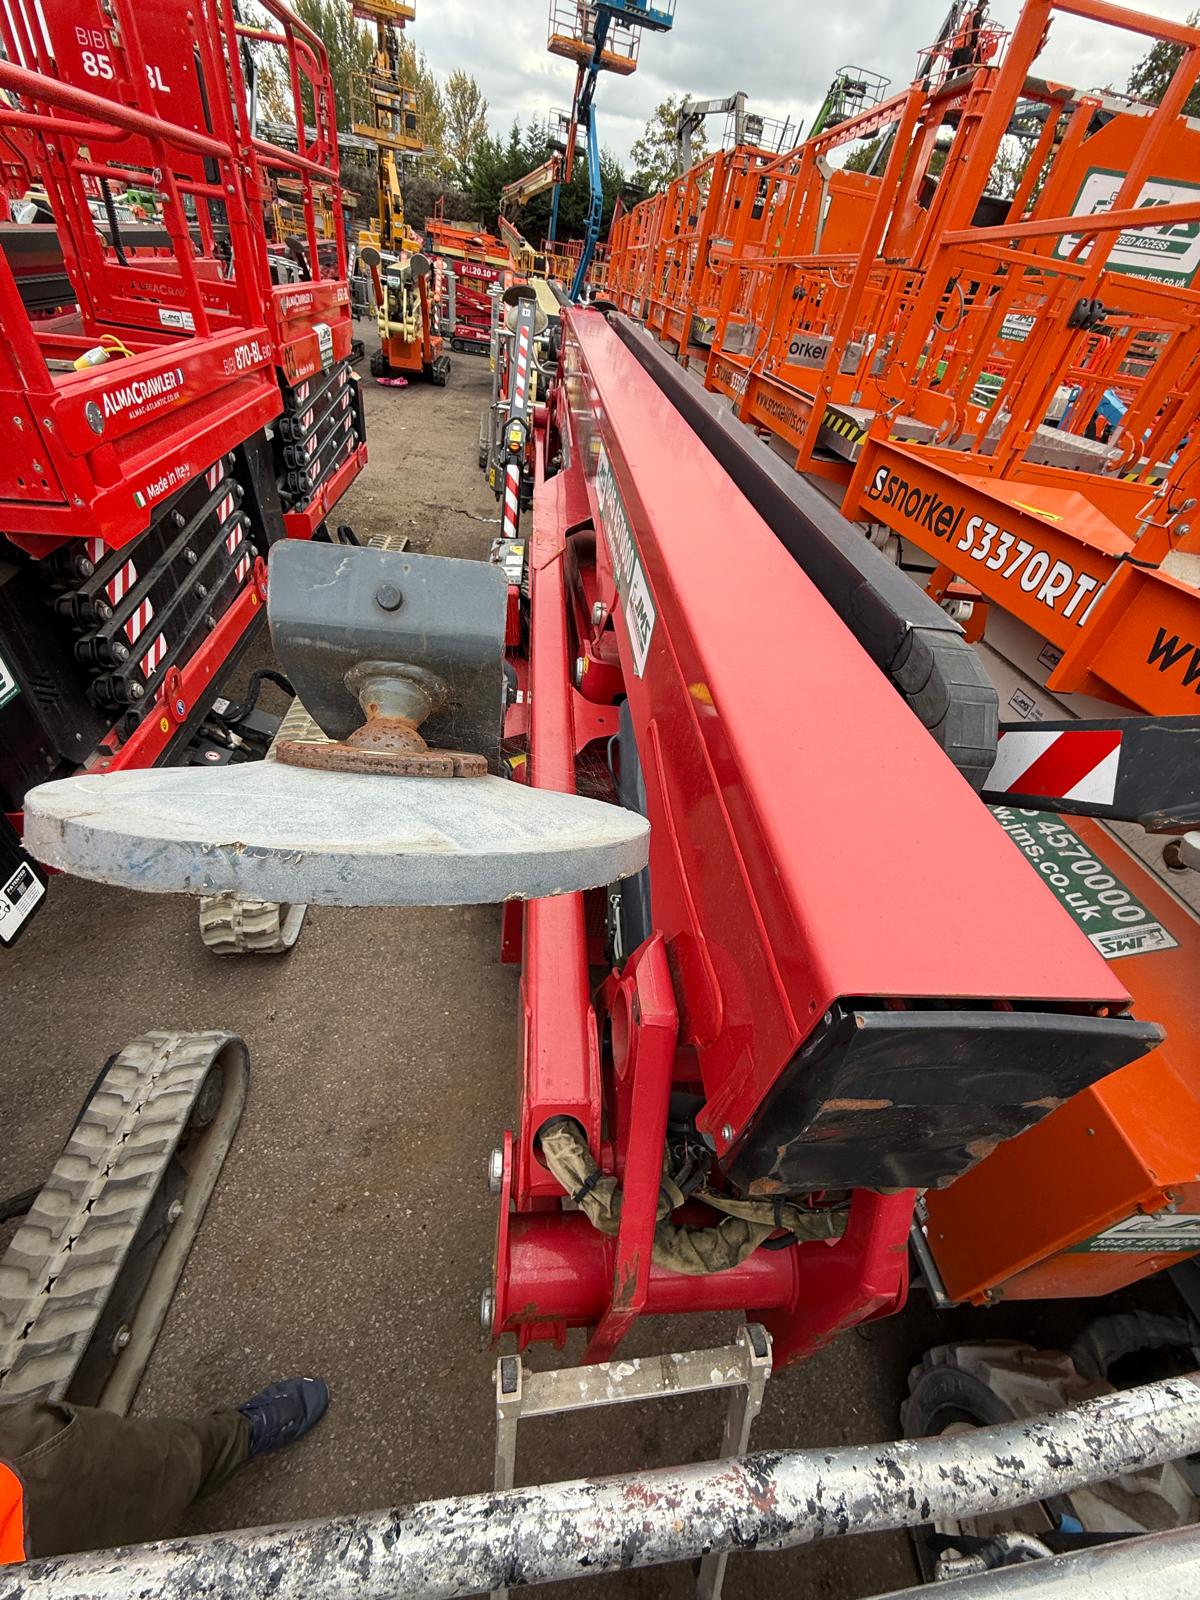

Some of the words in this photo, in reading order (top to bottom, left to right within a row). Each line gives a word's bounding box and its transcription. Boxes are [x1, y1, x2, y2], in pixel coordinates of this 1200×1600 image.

[75, 26, 110, 50] BIBI
[1135, 236, 1171, 251] ACCESS
[234, 341, 264, 370] 870-BL
[788, 341, 828, 361] orkel
[102, 370, 177, 419] ALMACRAWLER
[146, 476, 170, 501] Made
[167, 472, 176, 488] in
[6, 868, 26, 895] PATENTED
[1037, 820, 1147, 923] 4570000
[1101, 936, 1147, 955] JMS
